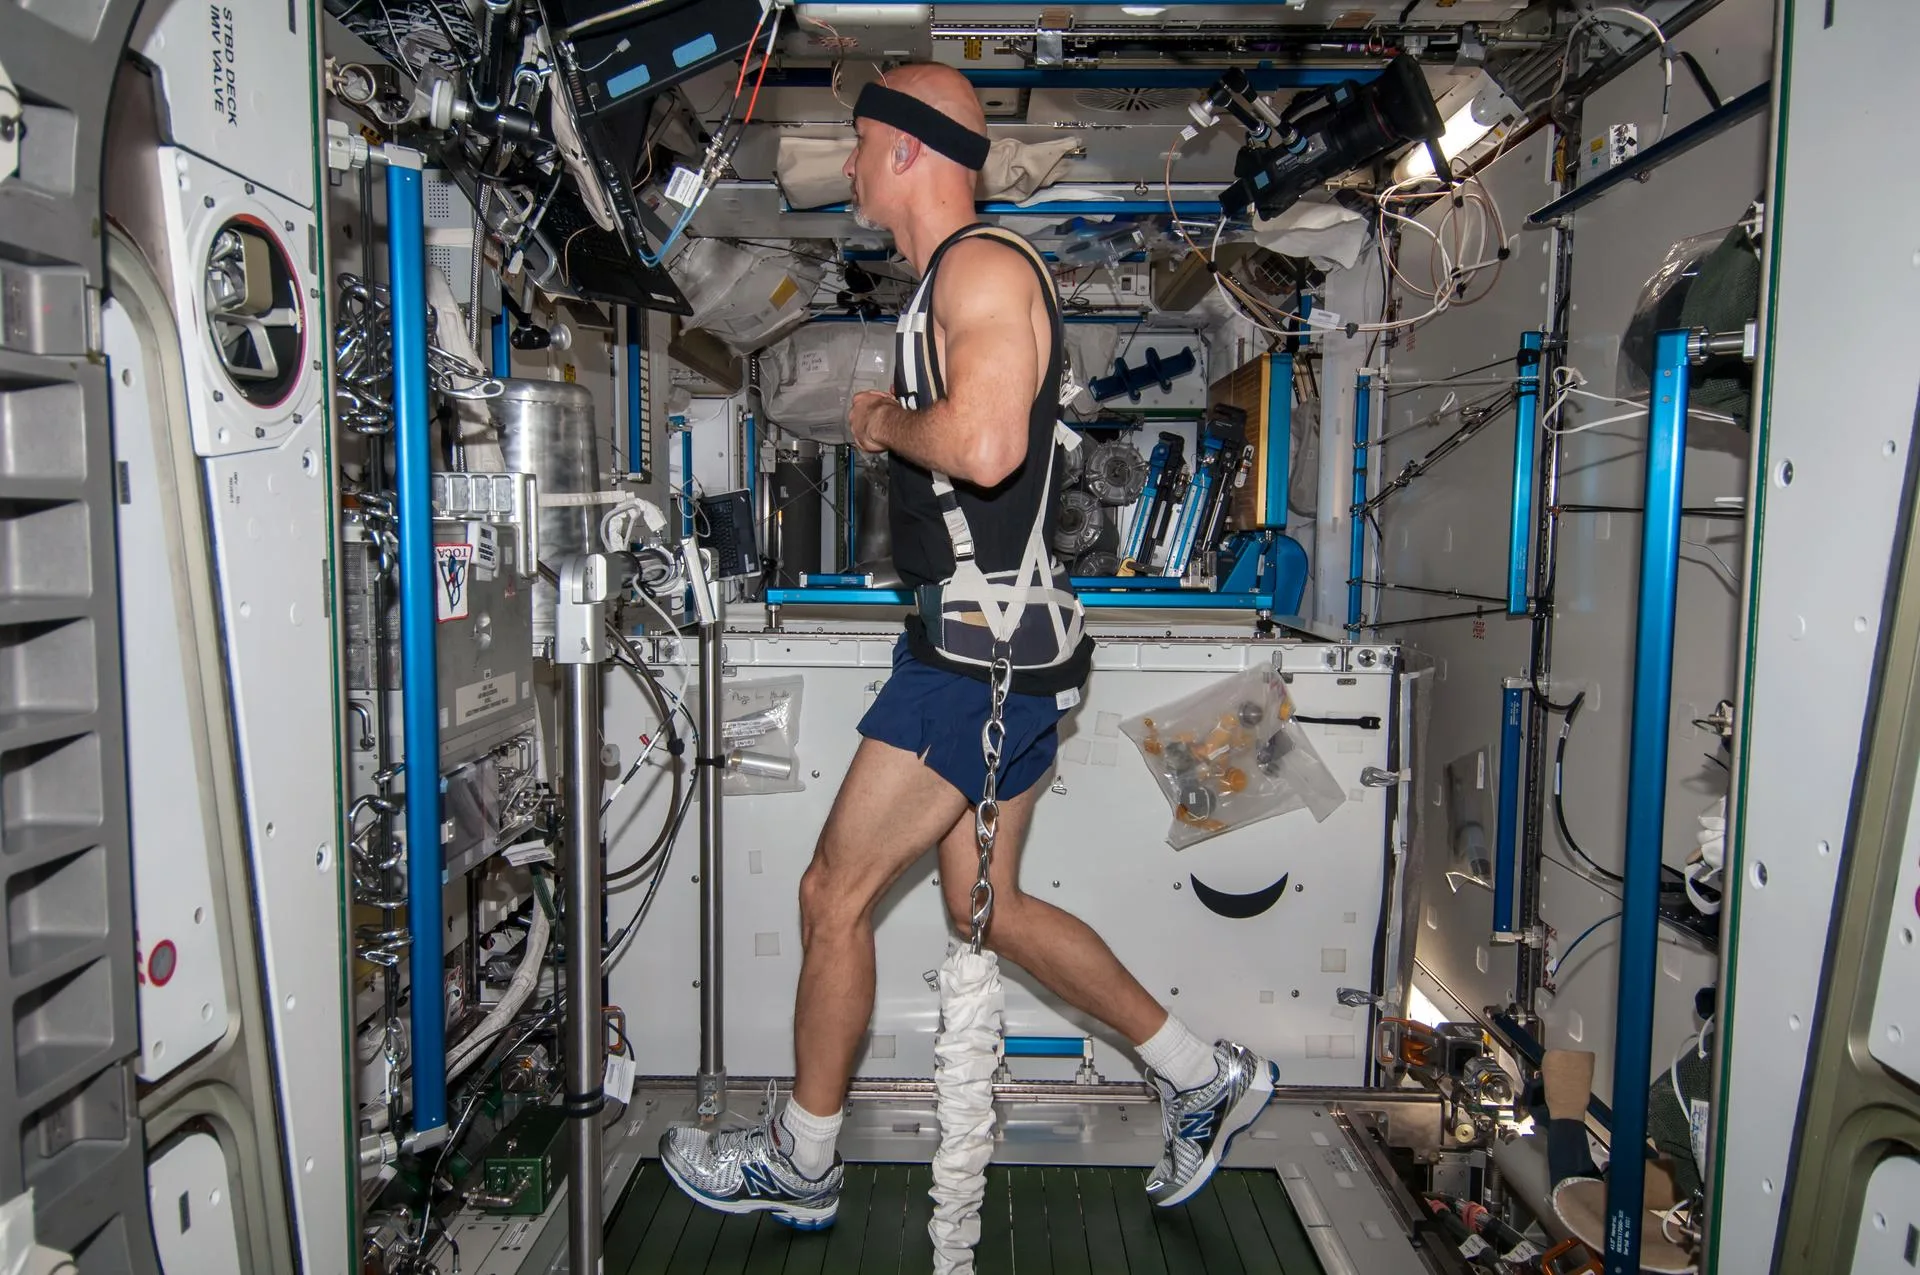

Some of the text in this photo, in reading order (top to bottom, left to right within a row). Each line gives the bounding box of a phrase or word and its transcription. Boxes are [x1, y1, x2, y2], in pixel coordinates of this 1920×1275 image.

[210, 4, 224, 115] IMV VALVE
[223, 7, 238, 128] STBD DECK
[437, 548, 468, 559] TOCA
